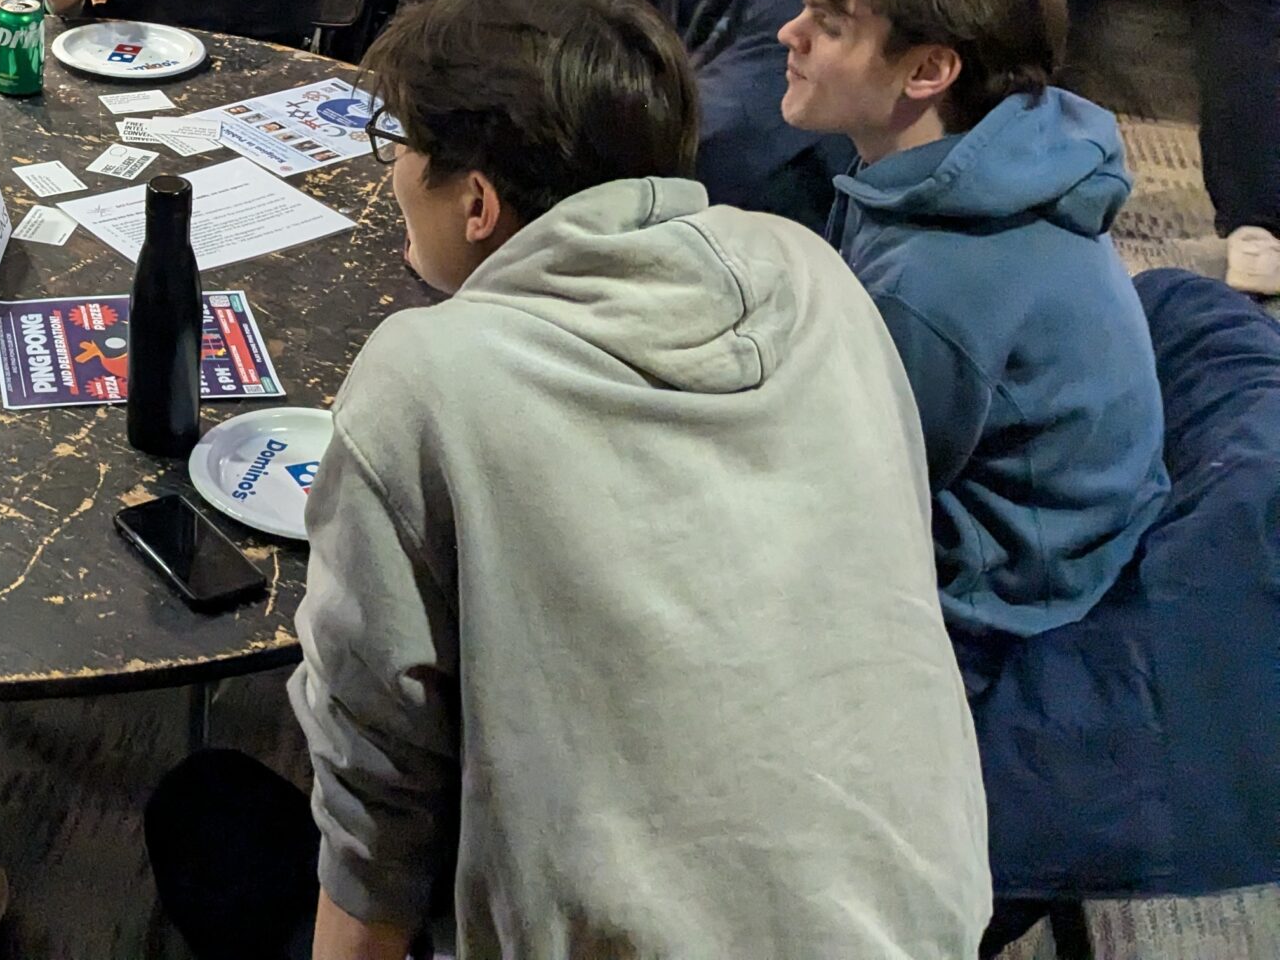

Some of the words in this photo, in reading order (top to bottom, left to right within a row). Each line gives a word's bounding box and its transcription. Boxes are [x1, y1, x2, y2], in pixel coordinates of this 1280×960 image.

[126, 60, 179, 71] mino's
[89, 303, 106, 331] PRIZES
[20, 313, 50, 355] PONG
[49, 315, 71, 369] DELIBERATION!
[28, 355, 58, 392] PING
[60, 370, 74, 387] AND
[104, 375, 121, 399] PIZZA
[214, 367, 234, 384] PM
[232, 439, 288, 502] Domino's
